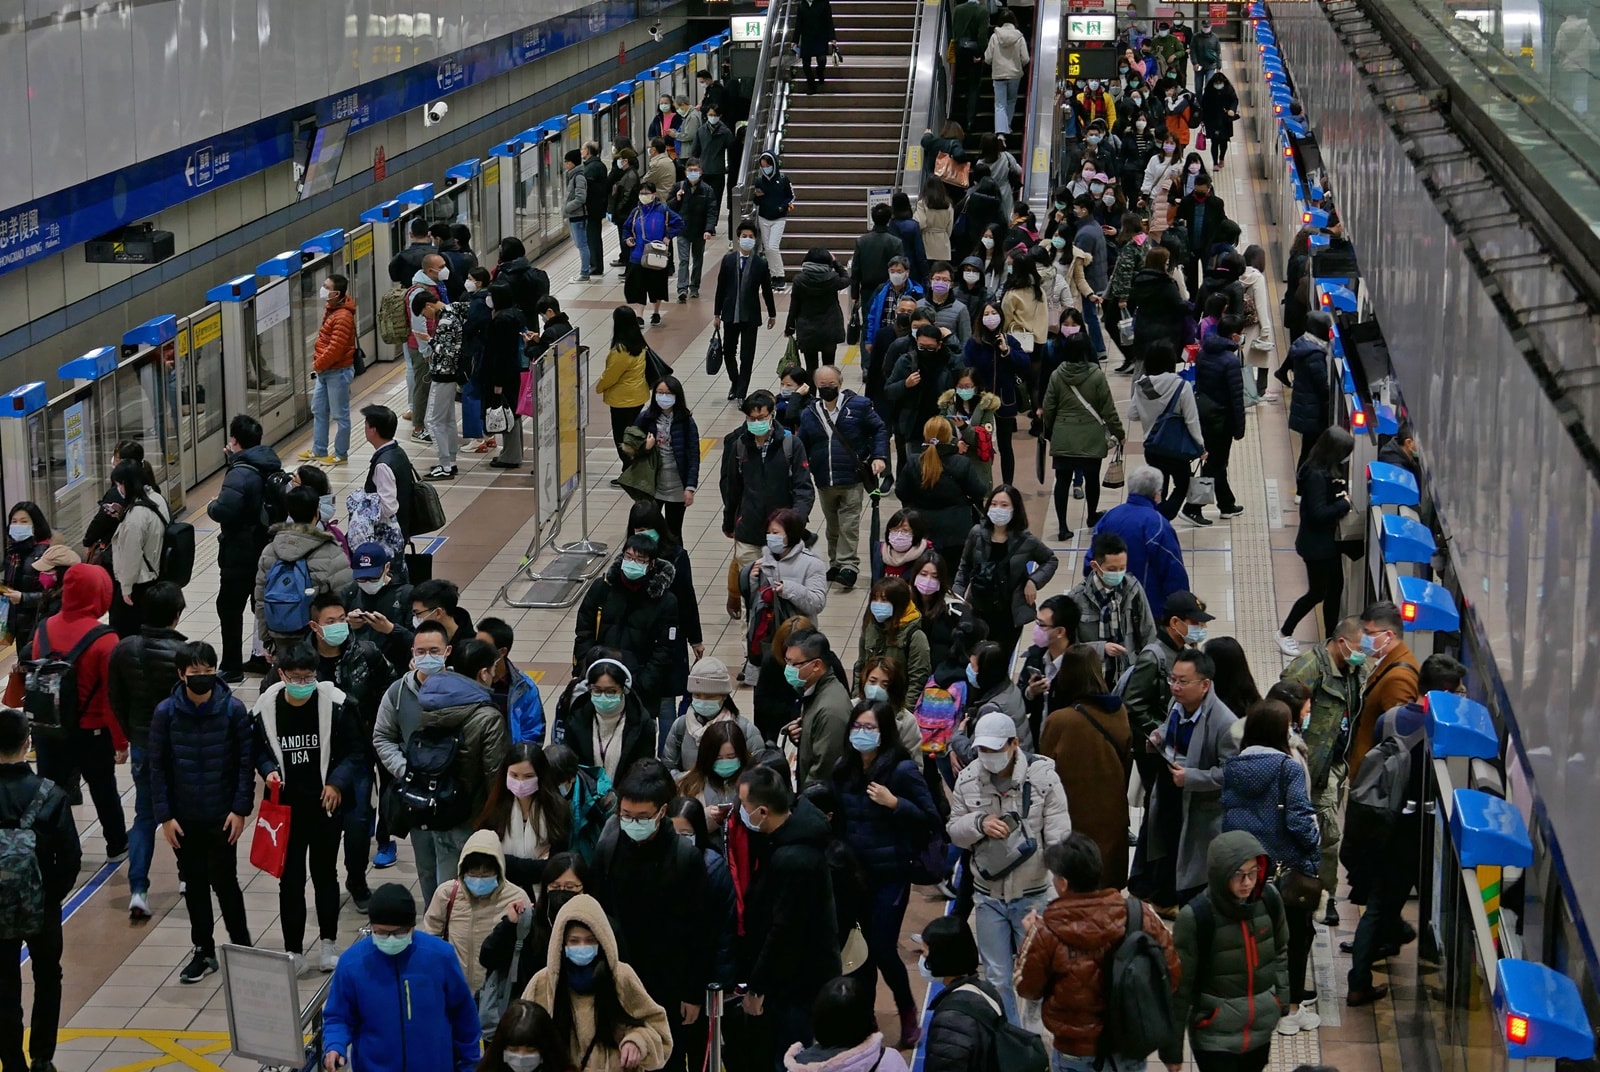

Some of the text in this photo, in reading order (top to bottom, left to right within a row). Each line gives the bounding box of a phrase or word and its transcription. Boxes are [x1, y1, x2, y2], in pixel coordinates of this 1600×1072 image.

[0, 209, 39, 249] 忠孝復興
[291, 750, 309, 765] USA
